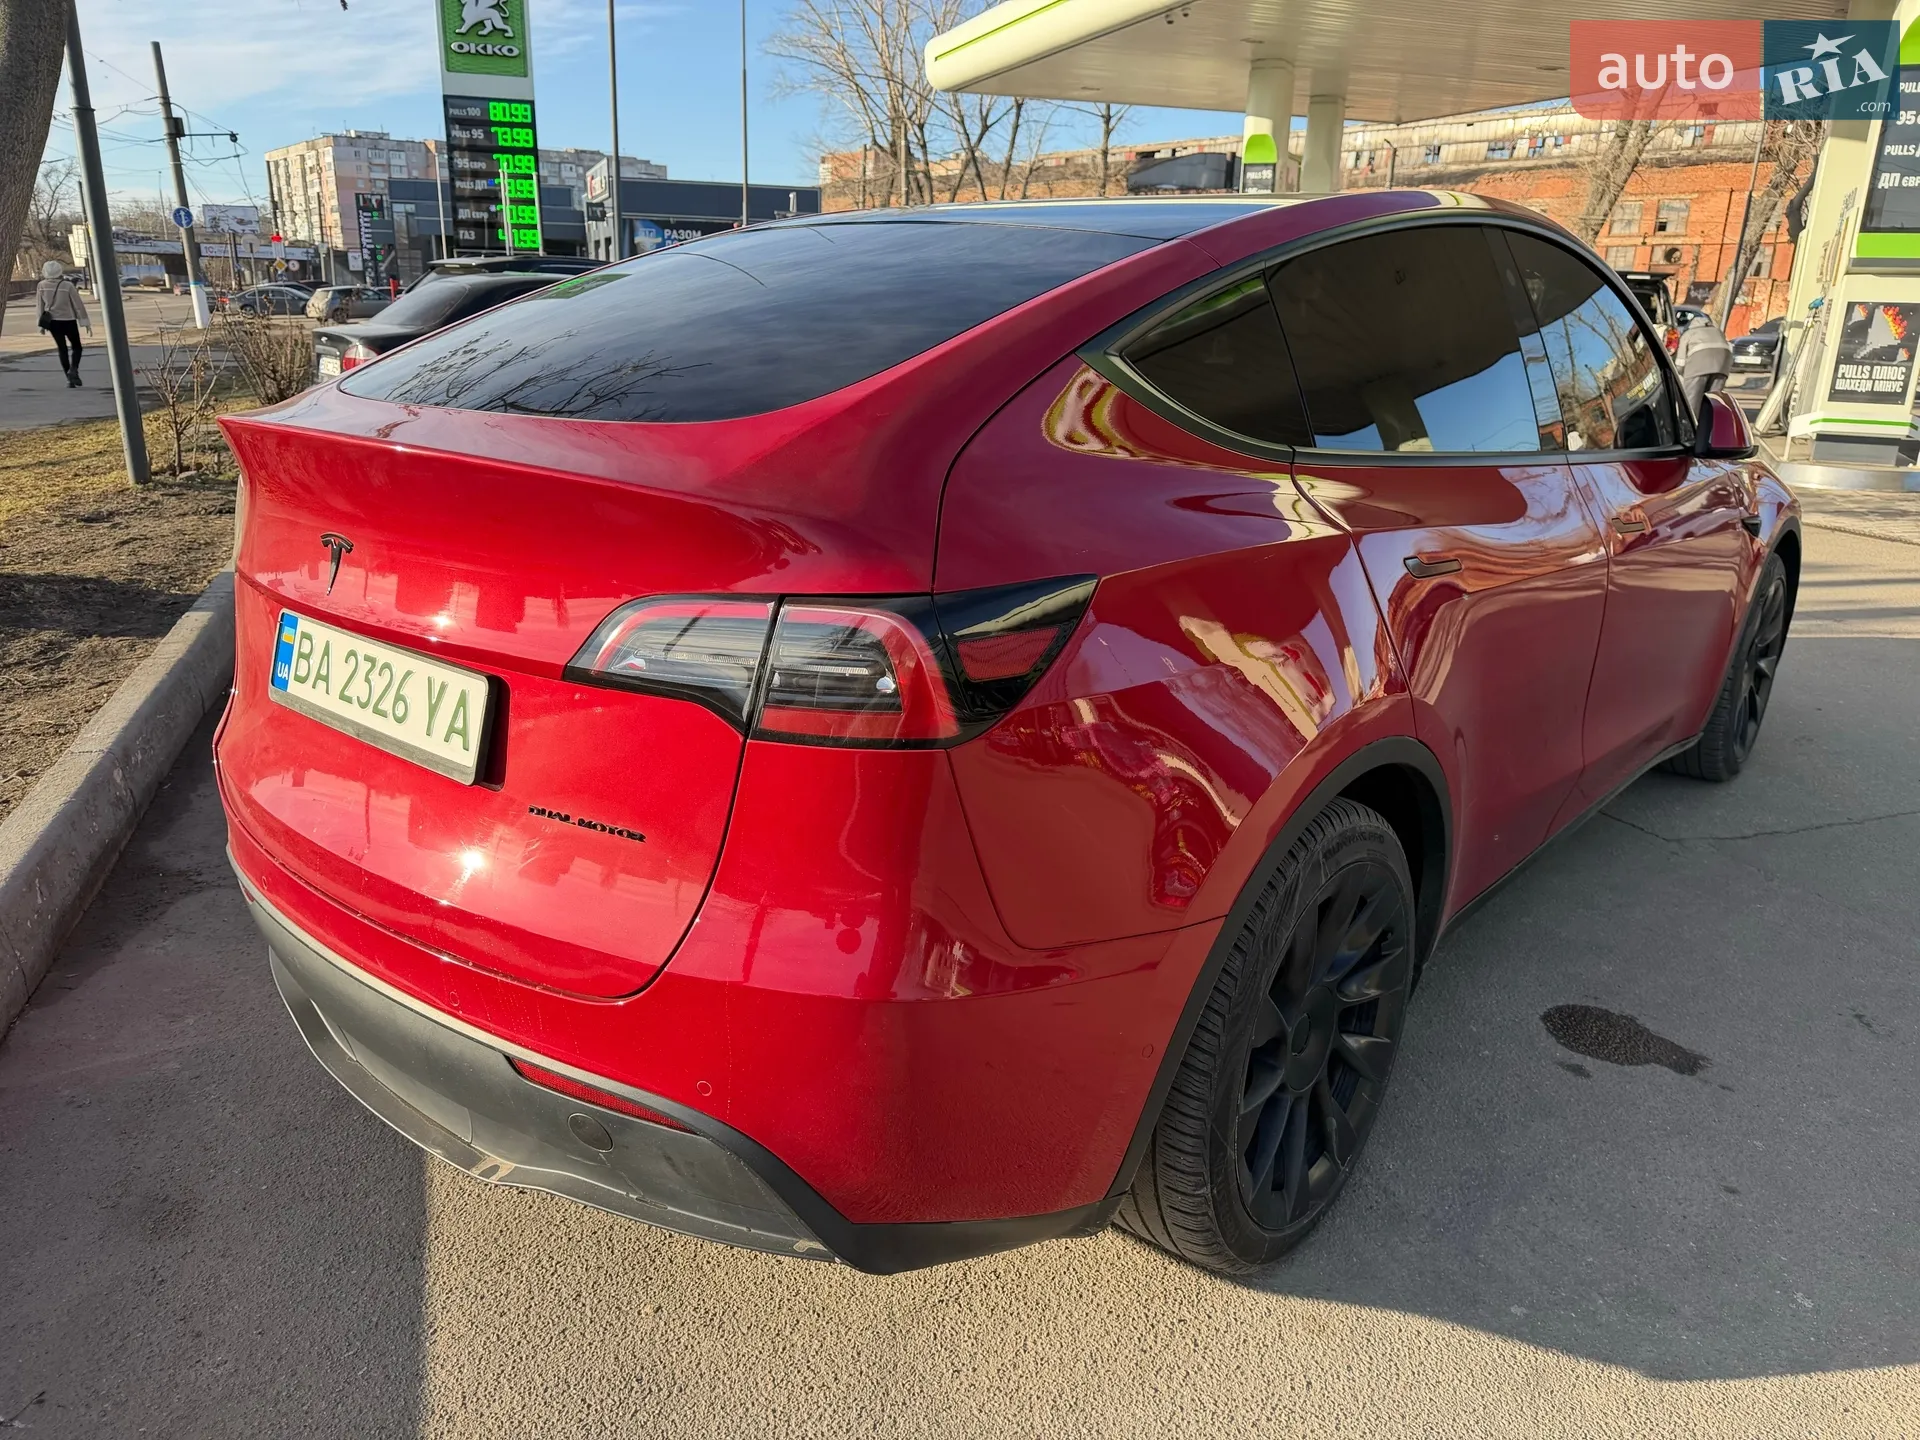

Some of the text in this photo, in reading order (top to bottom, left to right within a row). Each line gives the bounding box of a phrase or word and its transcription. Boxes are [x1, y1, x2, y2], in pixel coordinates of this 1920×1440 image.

[450, 41, 520, 57] OKKO
[448, 102, 532, 123] PULLS 100 80.99
[471, 128, 484, 139] 95
[491, 127, 534, 148] 73.99
[1883, 144, 1916, 156] PULLS
[1877, 172, 1900, 189] ДП
[458, 230, 476, 240] ГАЗ
[663, 228, 702, 240] РАЗОМ
[1837, 364, 1906, 381] PULLS ПЛЮС
[1834, 378, 1904, 393] ШАХЕДИ МІНУС
[276, 661, 290, 680] UA
[292, 630, 471, 752] BA 2326 YA
[528, 805, 647, 844] DUAL MOTOR
